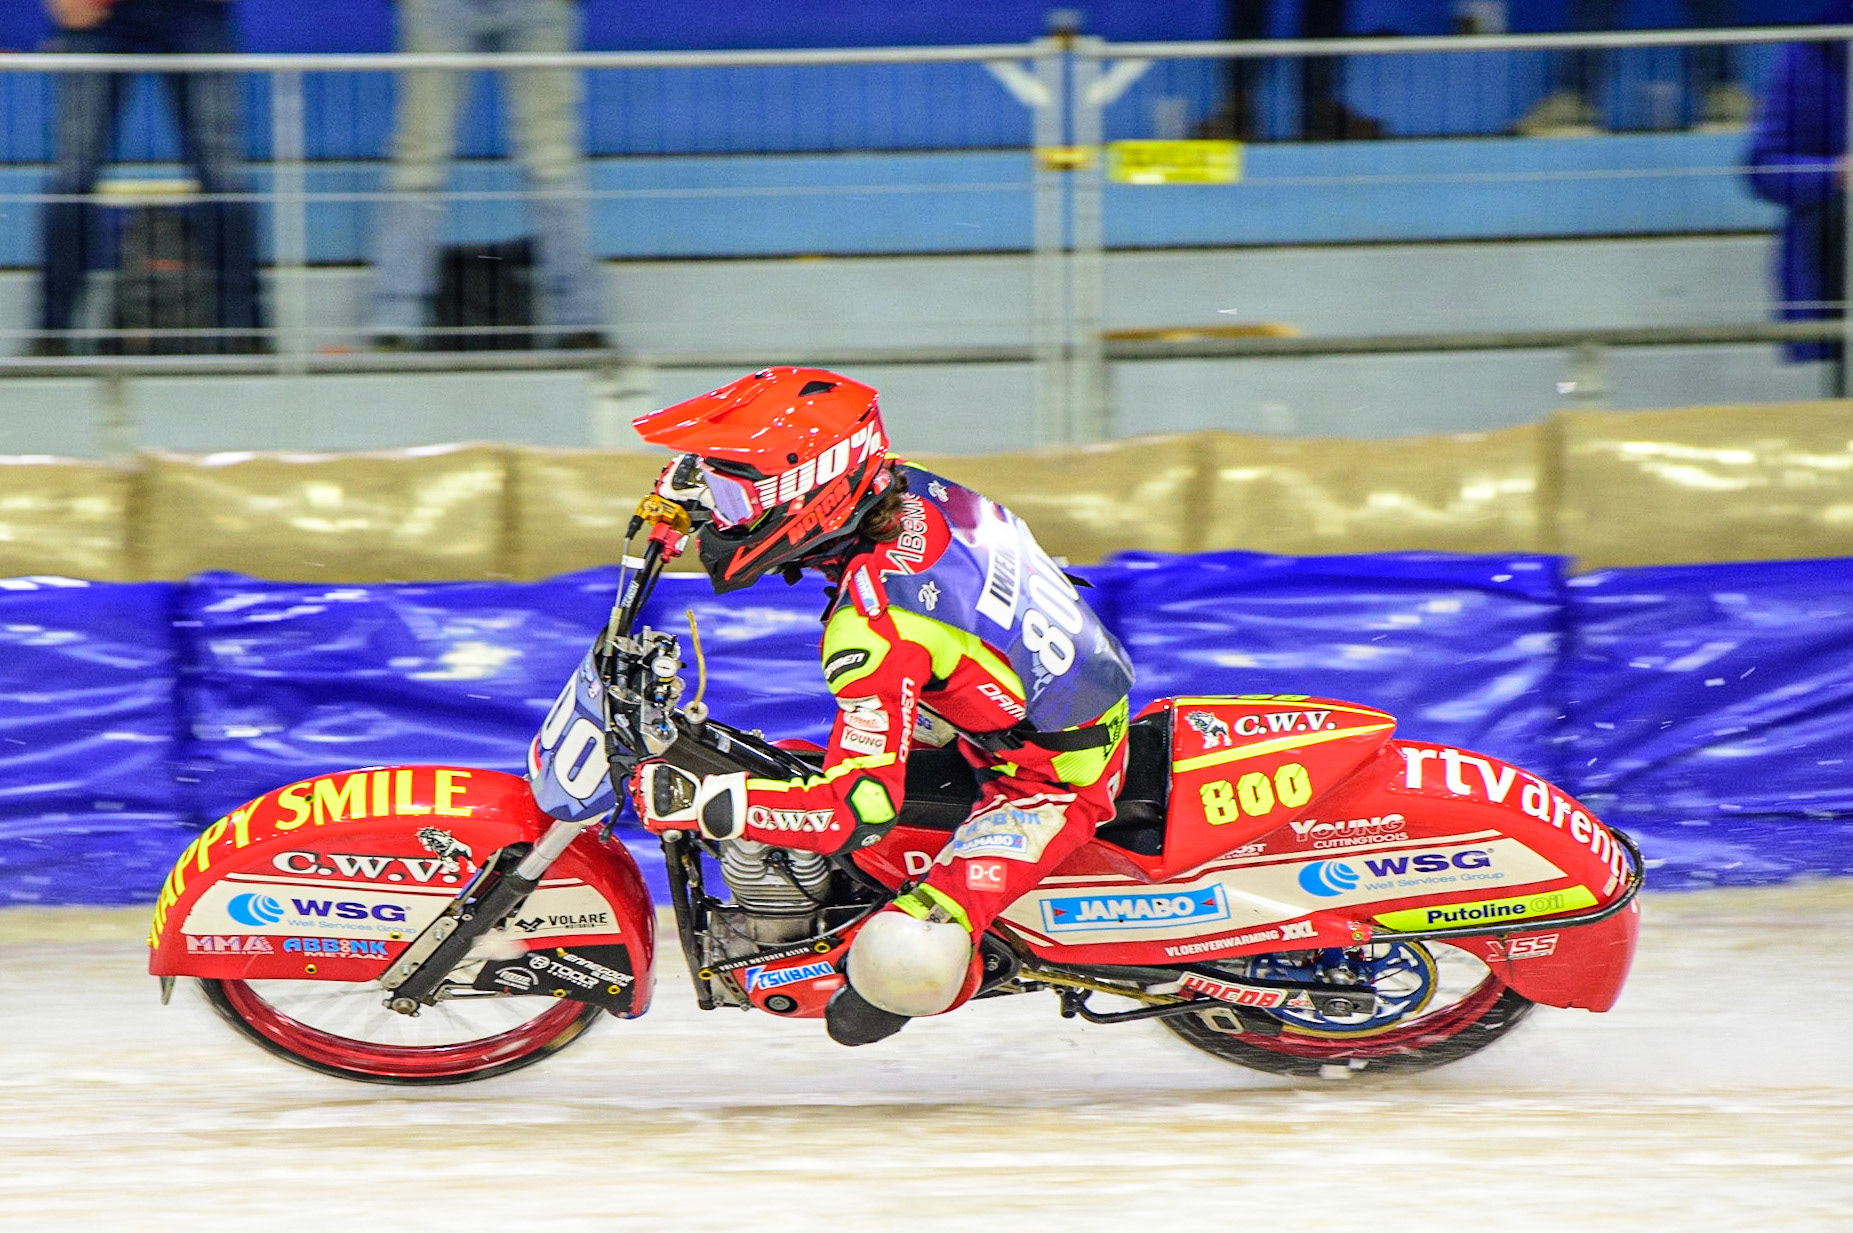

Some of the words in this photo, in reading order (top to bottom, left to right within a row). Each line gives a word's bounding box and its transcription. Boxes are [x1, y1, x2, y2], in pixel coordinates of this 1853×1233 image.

[753, 420, 882, 509] 100%
[1234, 710, 1337, 736] C.W.V.
[843, 728, 884, 749] YOUNG
[1199, 763, 1313, 826] 800
[746, 805, 841, 833] C.W.V.
[1289, 814, 1406, 842] YOUNG
[151, 796, 266, 950] HAPPY
[274, 769, 472, 831] SMILE
[272, 850, 458, 884] C.W.V.
[1364, 850, 1492, 878] WSG
[1399, 875, 1456, 887] Services
[1460, 871, 1505, 883] Group
[291, 898, 407, 922] WSG
[548, 912, 608, 926] VOLARE
[1076, 896, 1195, 921] JAMABO
[1428, 904, 1526, 924] Putoline
[1530, 894, 1564, 912] Oil
[319, 921, 373, 931] Services
[1165, 930, 1280, 957] VLOERVERWARMING
[1279, 920, 1318, 941] XXL
[304, 951, 390, 961] METAAL
[758, 962, 834, 988] TSUBAKI
